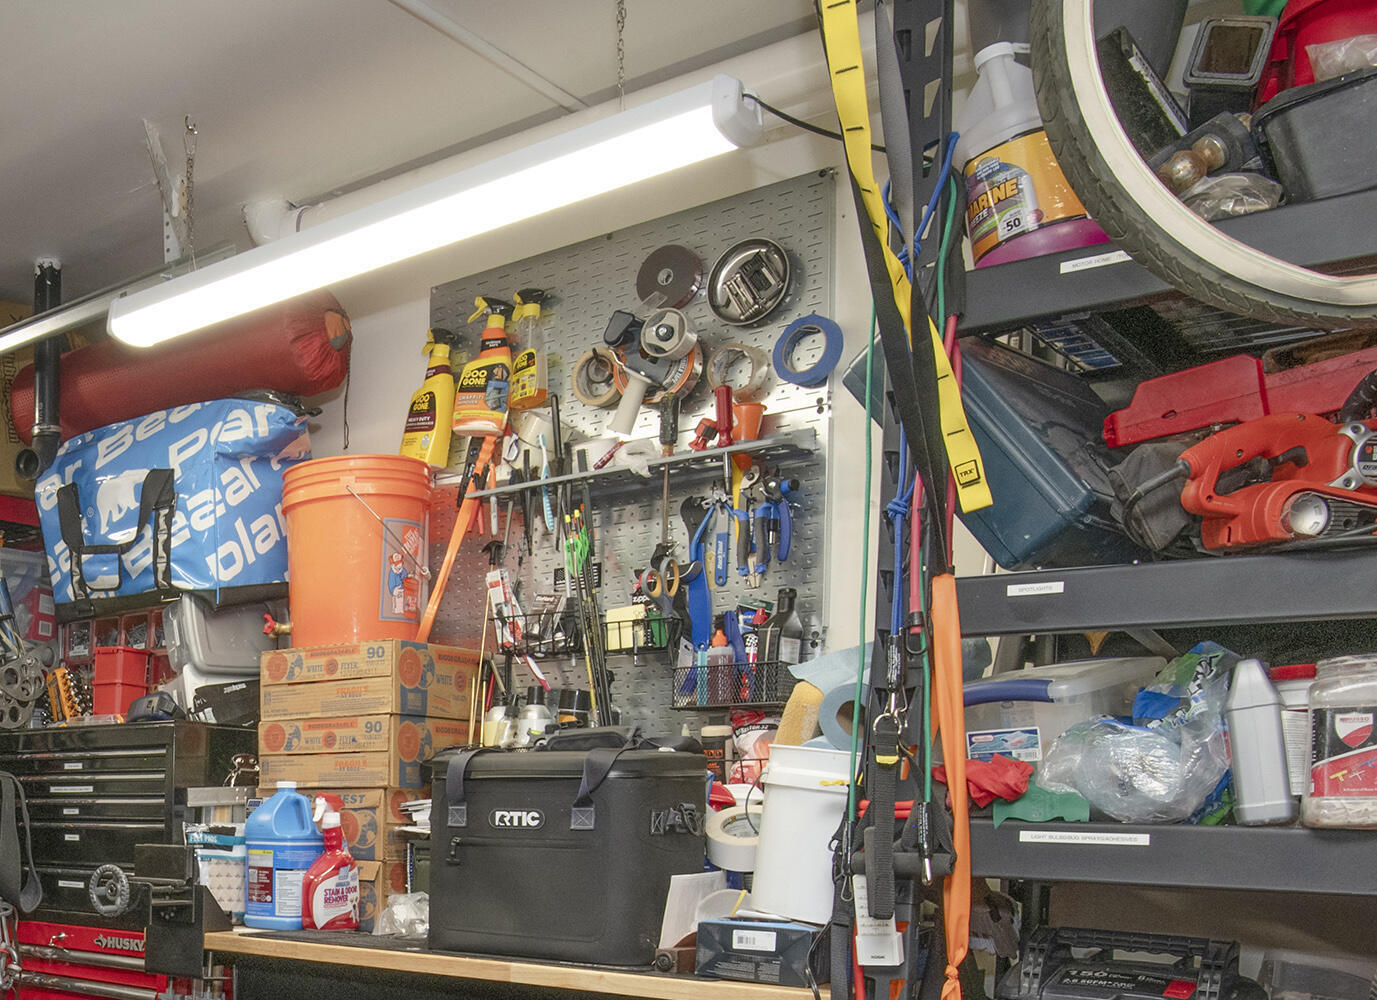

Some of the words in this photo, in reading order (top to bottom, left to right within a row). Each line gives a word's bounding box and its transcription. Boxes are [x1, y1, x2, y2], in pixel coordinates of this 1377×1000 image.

[464, 370, 487, 379] GOO
[463, 378, 486, 386] GONE
[415, 394, 429, 403] GOO
[960, 468, 974, 477] TRX
[367, 646, 385, 659] 90
[365, 721, 382, 733] 90
[495, 811, 540, 826] RTIC
[324, 888, 340, 896] STAIN
[345, 886, 357, 894] ODOR
[324, 895, 348, 903] REMOVER
[107, 936, 145, 951] HUSKY
